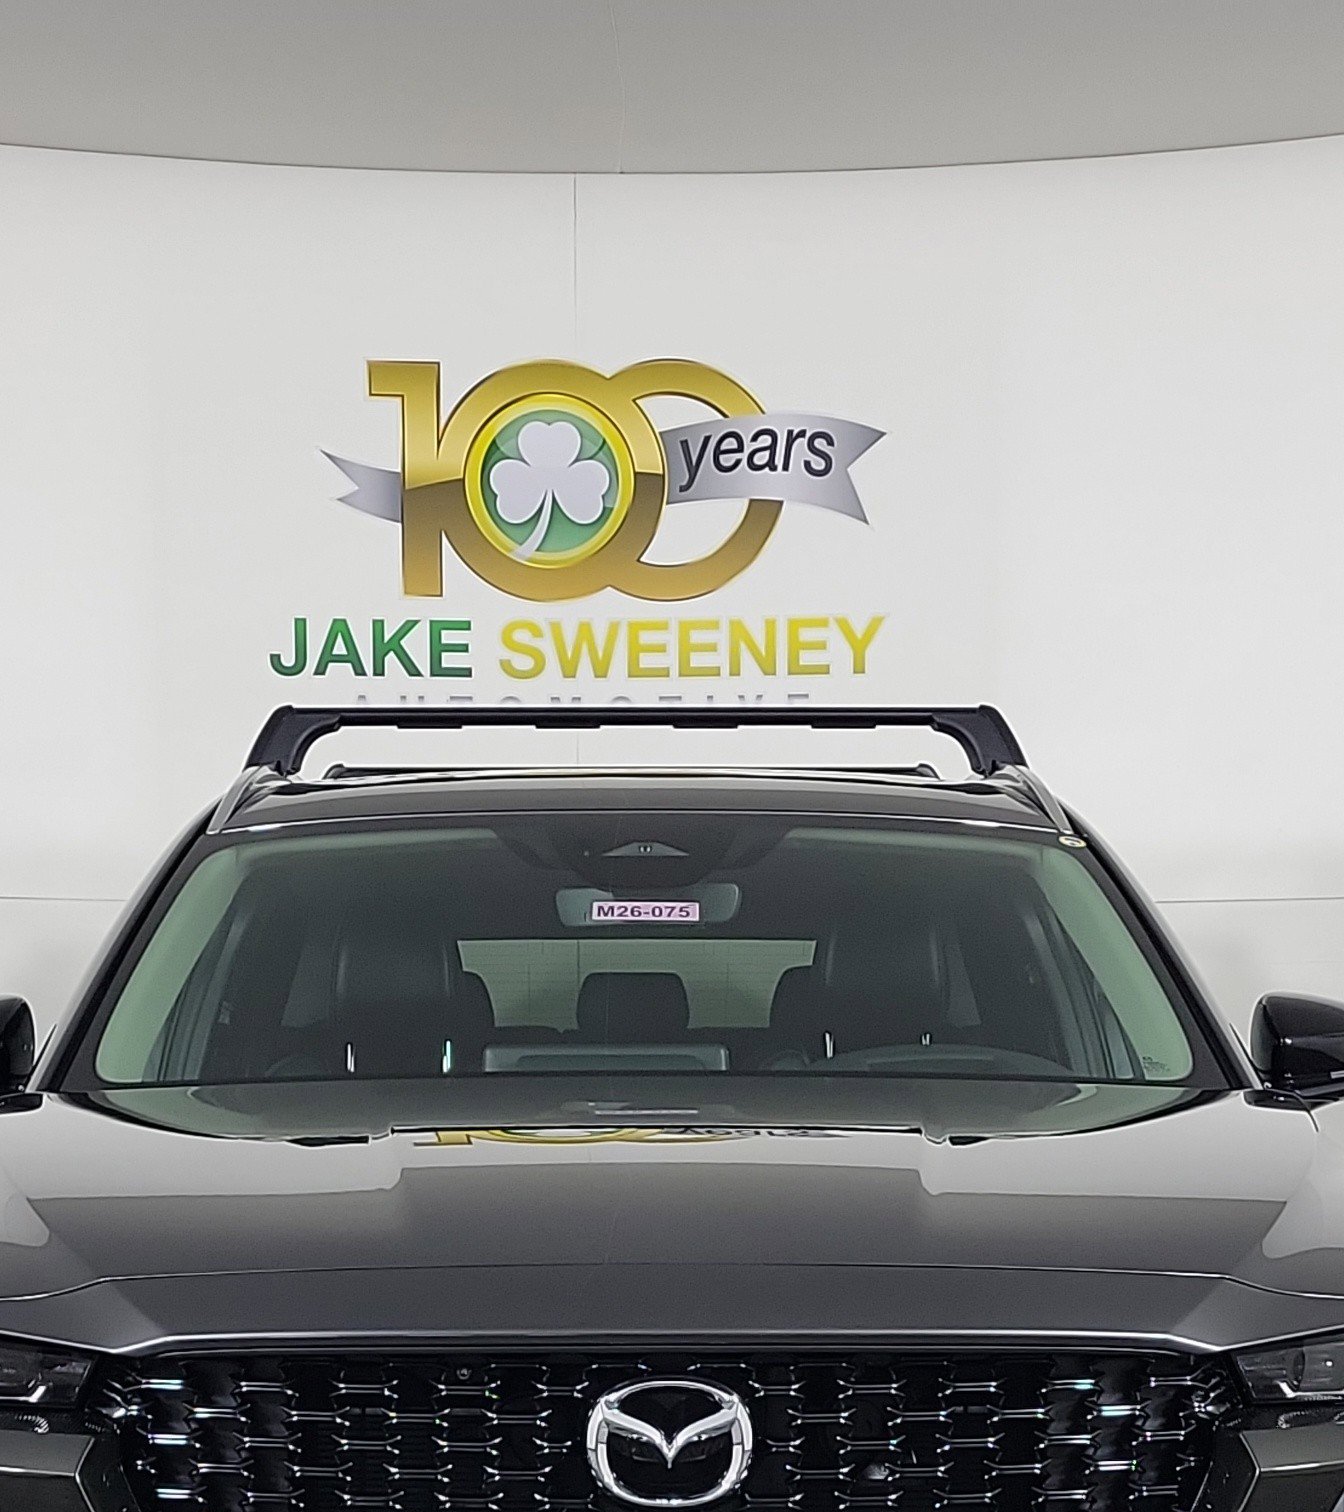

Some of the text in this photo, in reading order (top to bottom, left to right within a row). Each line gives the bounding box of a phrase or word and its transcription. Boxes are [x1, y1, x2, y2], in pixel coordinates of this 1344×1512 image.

[367, 358, 833, 602] 100 years
[270, 616, 885, 680] JAKE SWEENEY
[596, 905, 691, 918] M26-075
